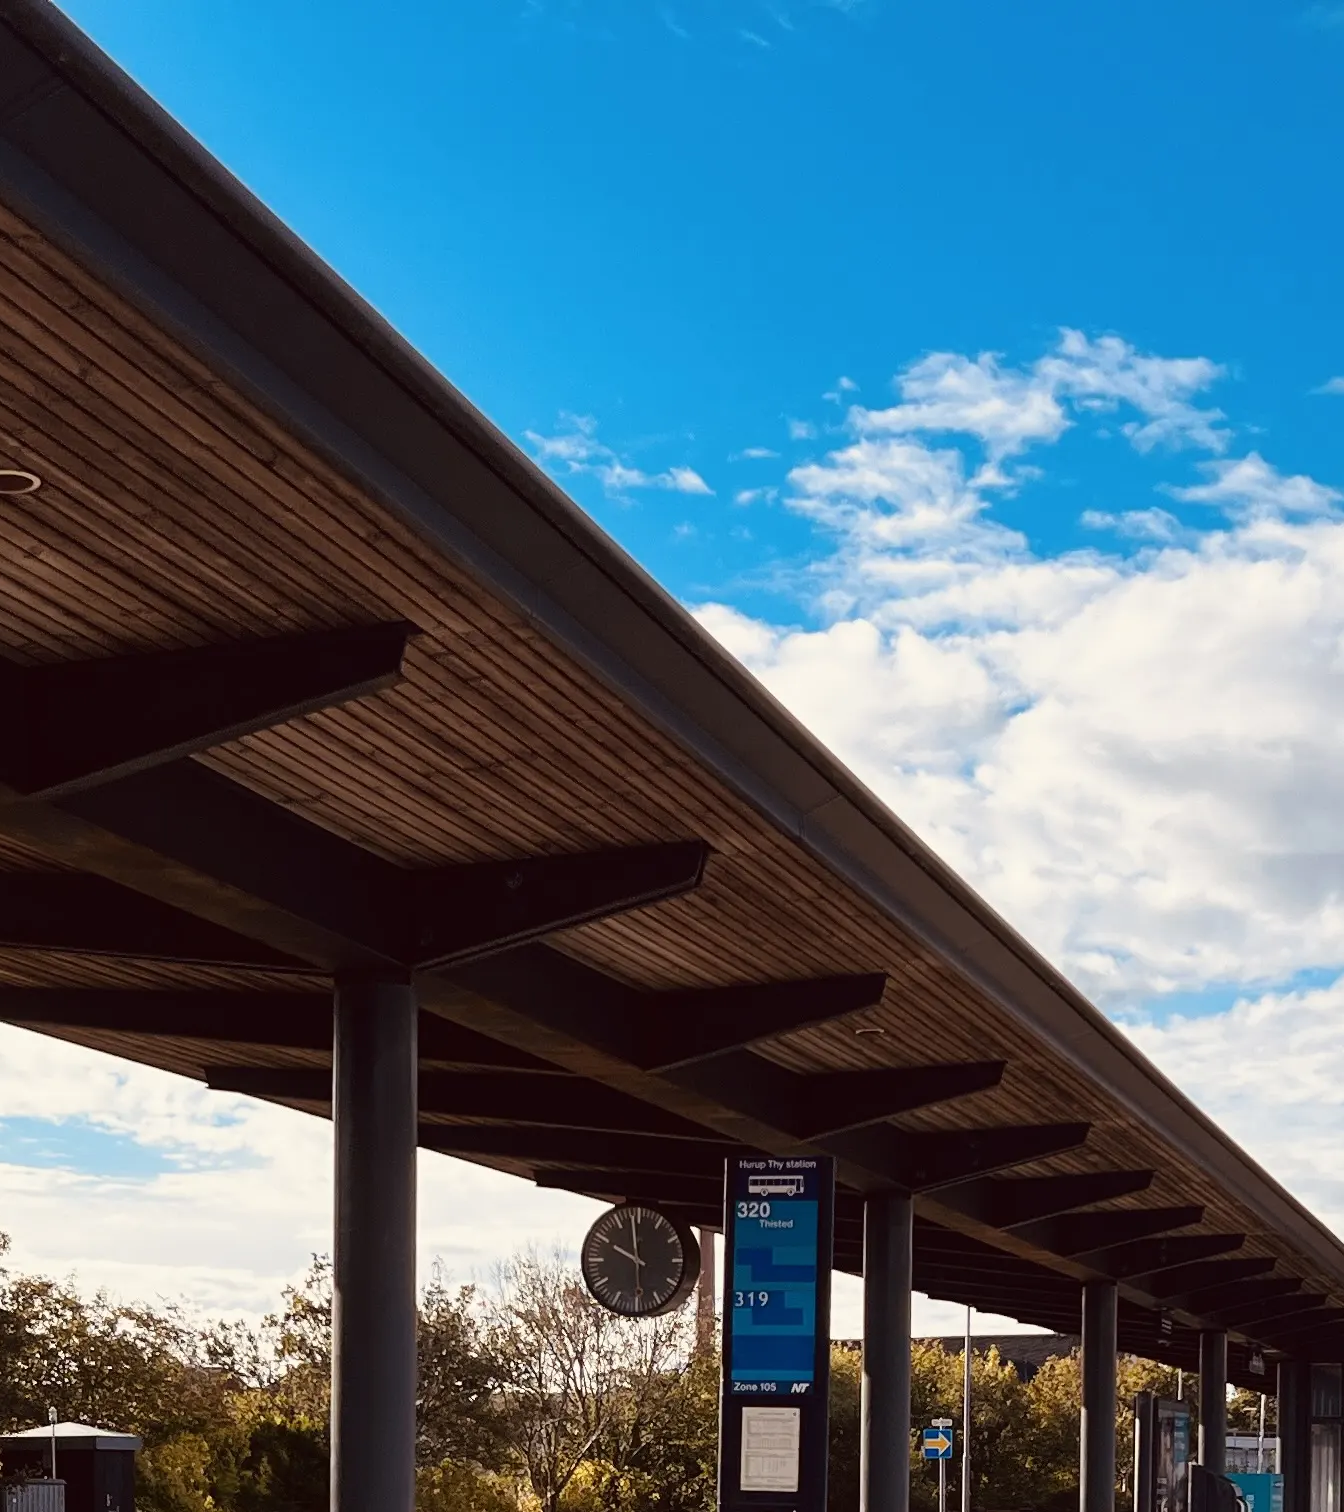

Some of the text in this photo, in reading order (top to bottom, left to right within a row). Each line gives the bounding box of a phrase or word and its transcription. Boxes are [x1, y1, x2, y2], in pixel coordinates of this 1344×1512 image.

[739, 1160, 816, 1170] Hurup Thy station
[737, 1202, 771, 1218] 320
[759, 1219, 794, 1229] Thisted
[734, 1291, 769, 1307] 319
[733, 1382, 777, 1392] Zone 105
[790, 1383, 810, 1394] NT
